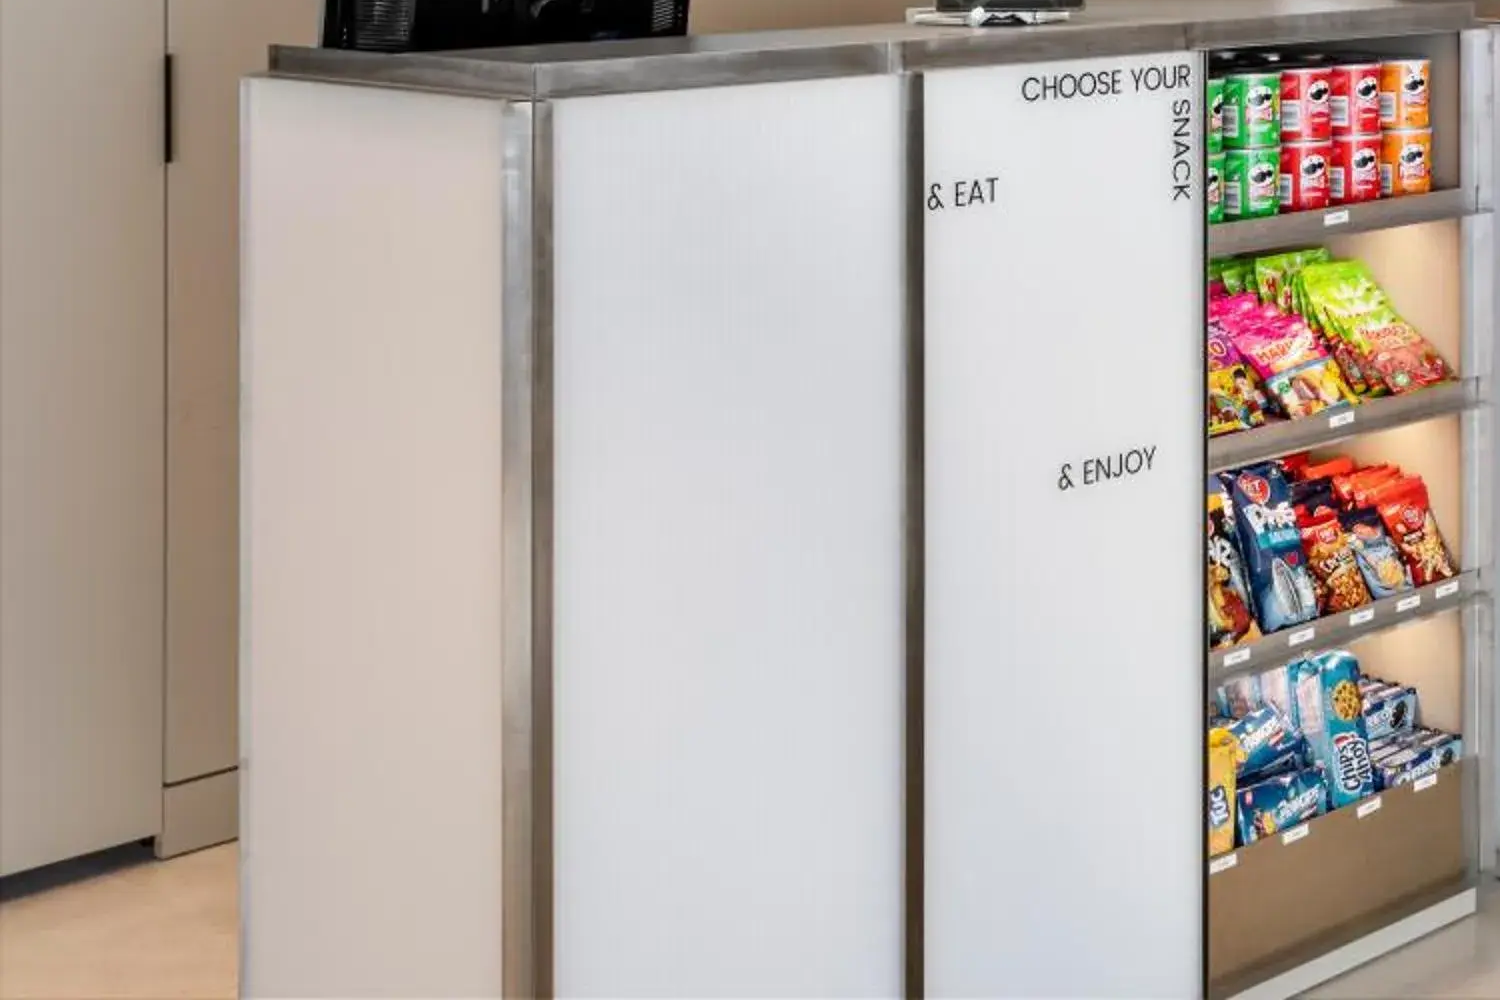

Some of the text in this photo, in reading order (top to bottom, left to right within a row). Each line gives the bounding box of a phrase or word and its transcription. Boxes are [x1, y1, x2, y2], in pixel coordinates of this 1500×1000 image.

[1021, 64, 1191, 102] CHOOSE YOUR
[1172, 99, 1191, 201] SNACK
[927, 177, 999, 211] & EAT
[1058, 445, 1157, 491] & ENJOY
[1210, 785, 1229, 827] TUC
